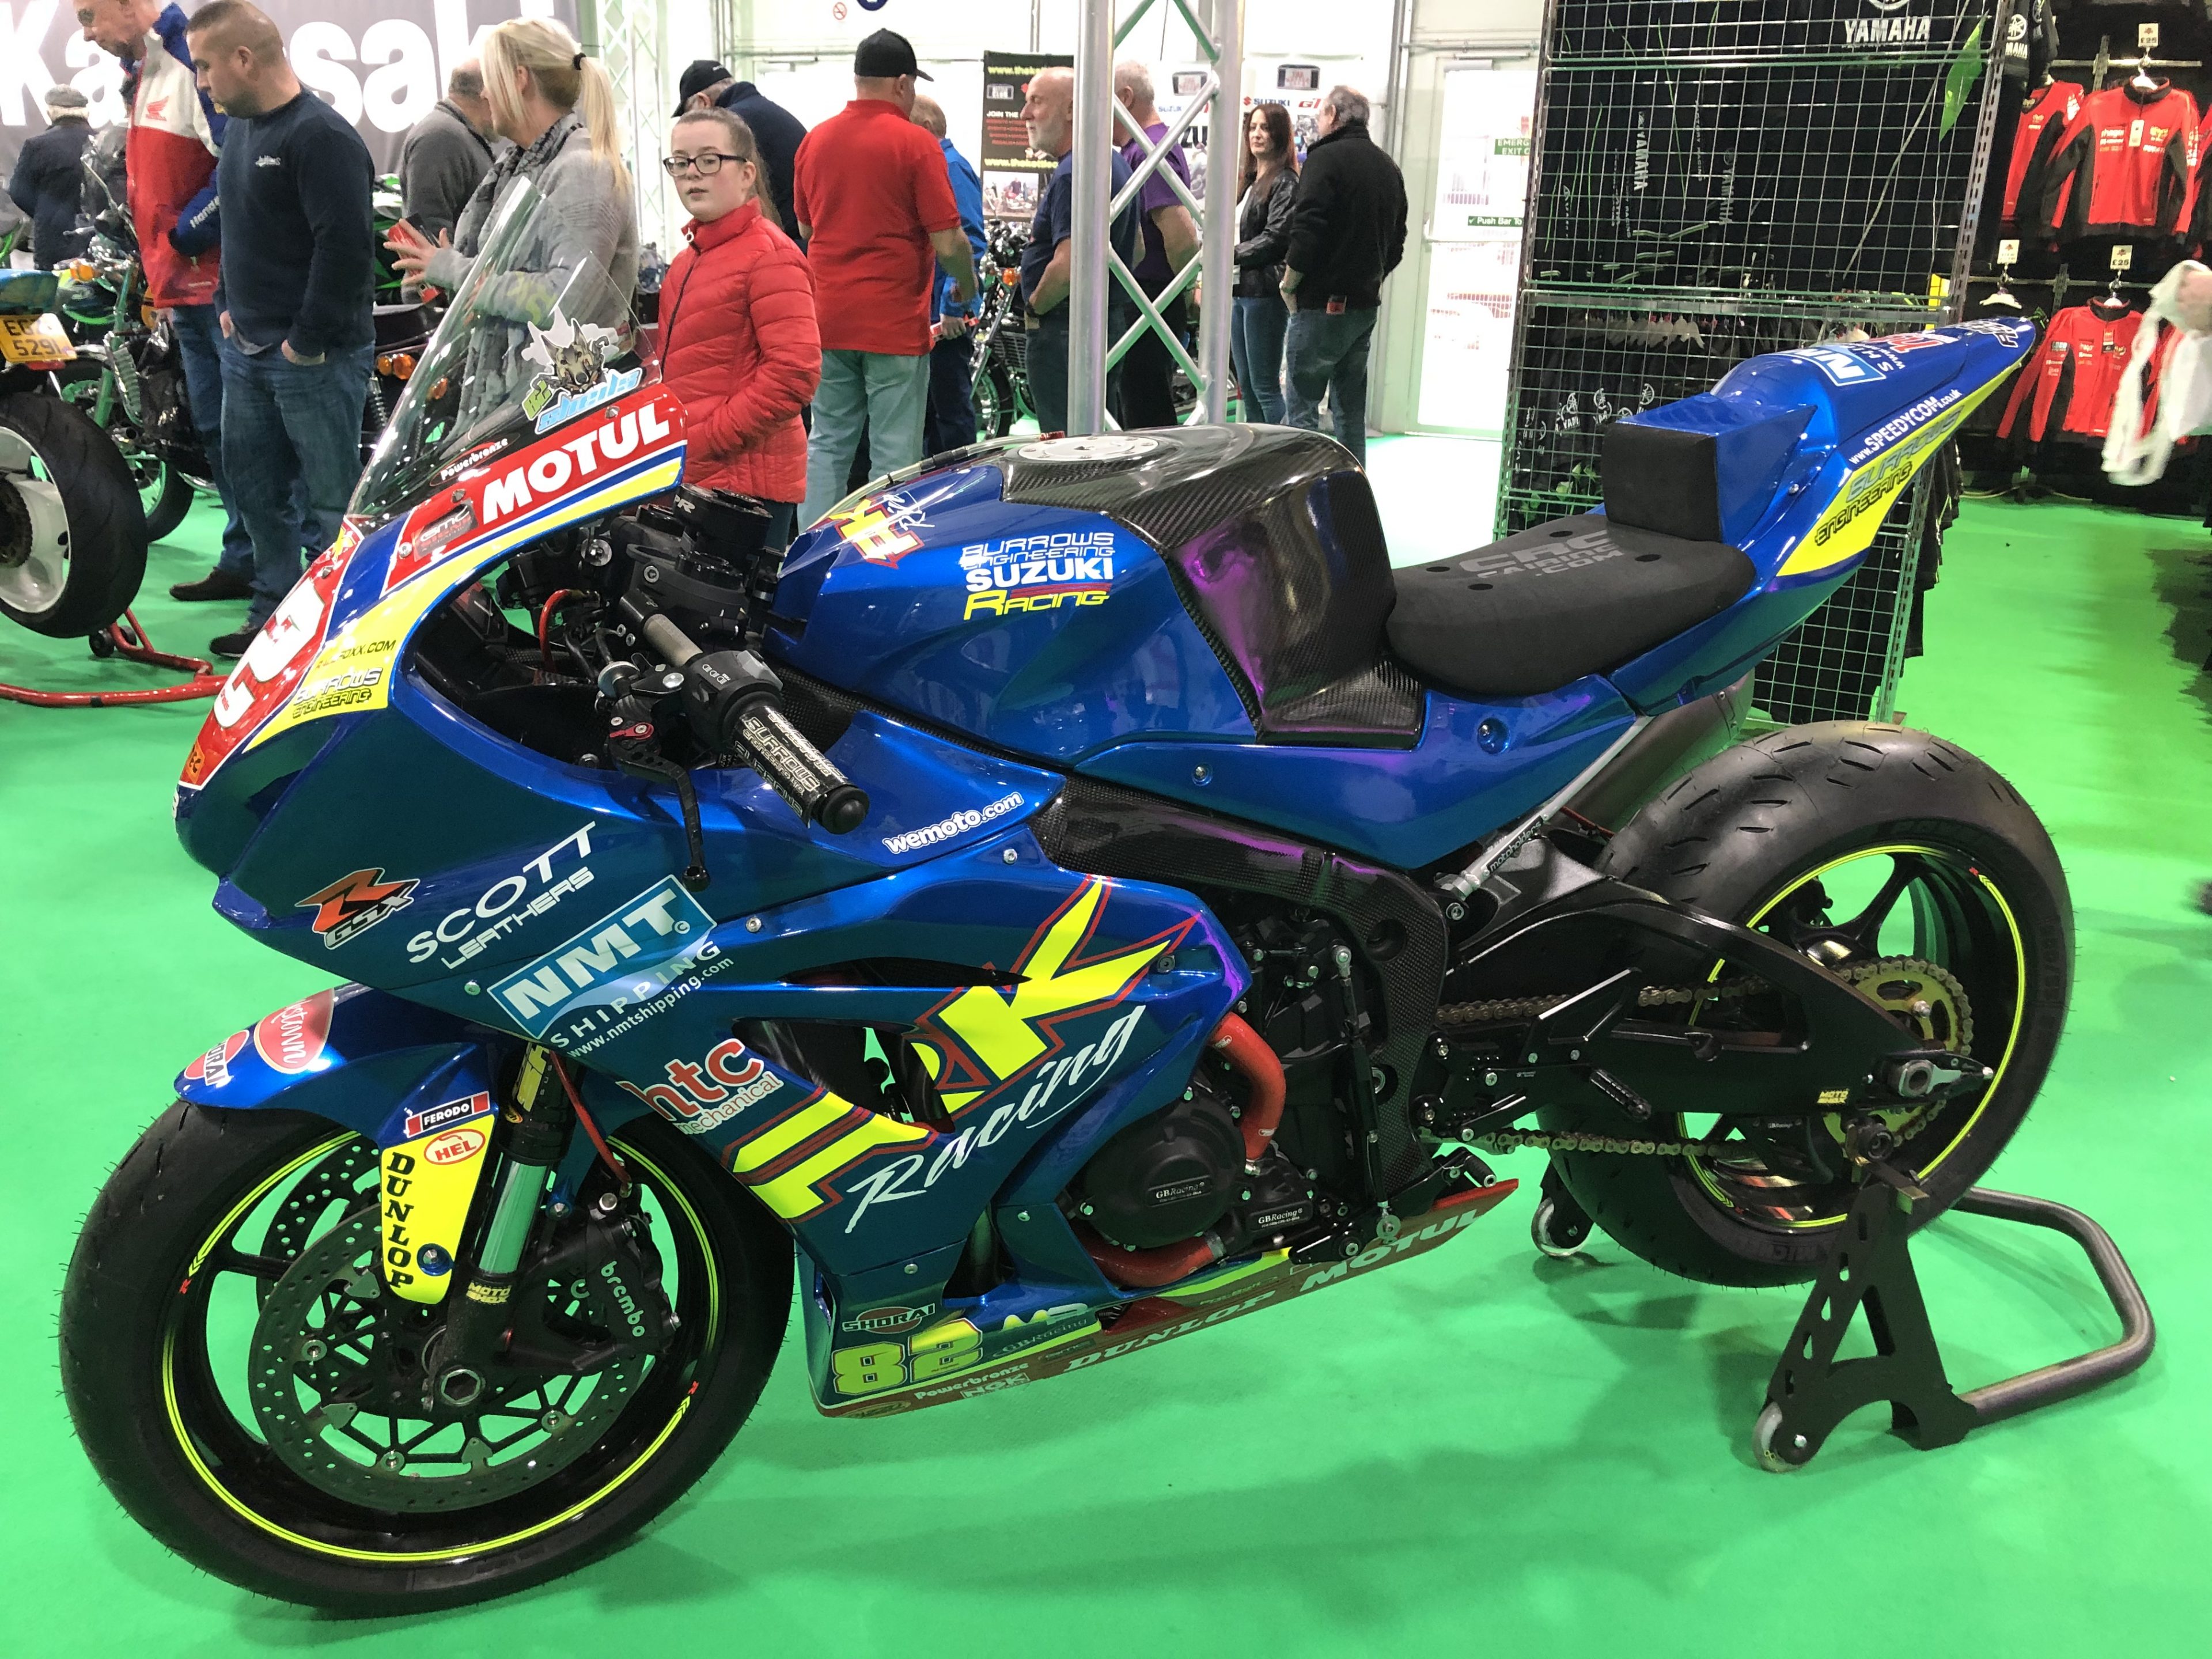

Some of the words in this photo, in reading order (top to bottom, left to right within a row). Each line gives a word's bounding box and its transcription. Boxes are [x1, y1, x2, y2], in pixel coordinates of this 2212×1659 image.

[1844, 16, 1930, 43] YAMAHA
[2006, 42, 2028, 59] MAHA
[1253, 97, 1290, 107] SUZUKI
[1498, 138, 1530, 146] EMERG
[1502, 147, 1522, 155] EXIT
[1633, 131, 1649, 191] YAMAHA
[1477, 217, 1496, 225] Push
[1498, 217, 1512, 226] Bar
[1514, 218, 1522, 226] To
[440, 438, 508, 481] Powerbronze
[483, 403, 670, 525] MOTUL
[1845, 404, 1965, 504] BURROWS
[1814, 460, 1913, 546] ENGINEERING
[961, 532, 1115, 558] BURROWS
[963, 547, 1116, 570] ENGINEERING
[1459, 529, 1611, 572] CRC
[965, 557, 1114, 592] SUZUKI
[292, 688, 372, 719] ENGINEERING
[743, 716, 820, 792] BURROWS
[743, 728, 791, 780] ENGINEERING
[882, 791, 1025, 854] wemoto.com
[1489, 821, 1542, 872] motoholders
[406, 820, 596, 963] SCOTT
[441, 866, 595, 969] LEATHERS
[502, 888, 680, 1020] NMT
[550, 941, 722, 1048] SHIPPING
[566, 956, 734, 1059] www.nmtshipping.com
[615, 1038, 764, 1121] htc
[675, 1072, 783, 1134] mechanical
[423, 1103, 470, 1126] FERODO
[844, 1005, 1146, 1234] Racing
[434, 1140, 478, 1161] HEL
[384, 1152, 416, 1288] DUNLOP
[1258, 1208, 1298, 1224] GBRacing
[1300, 1209, 1481, 1292] MOTUL
[468, 1282, 513, 1296] MOTO
[601, 1260, 645, 1337] brembo
[842, 1303, 935, 1332] SHORAI
[1063, 1290, 1276, 1372] DUNLOP
[831, 1317, 983, 1396] 82
[914, 1362, 1029, 1400] Powerbronze
